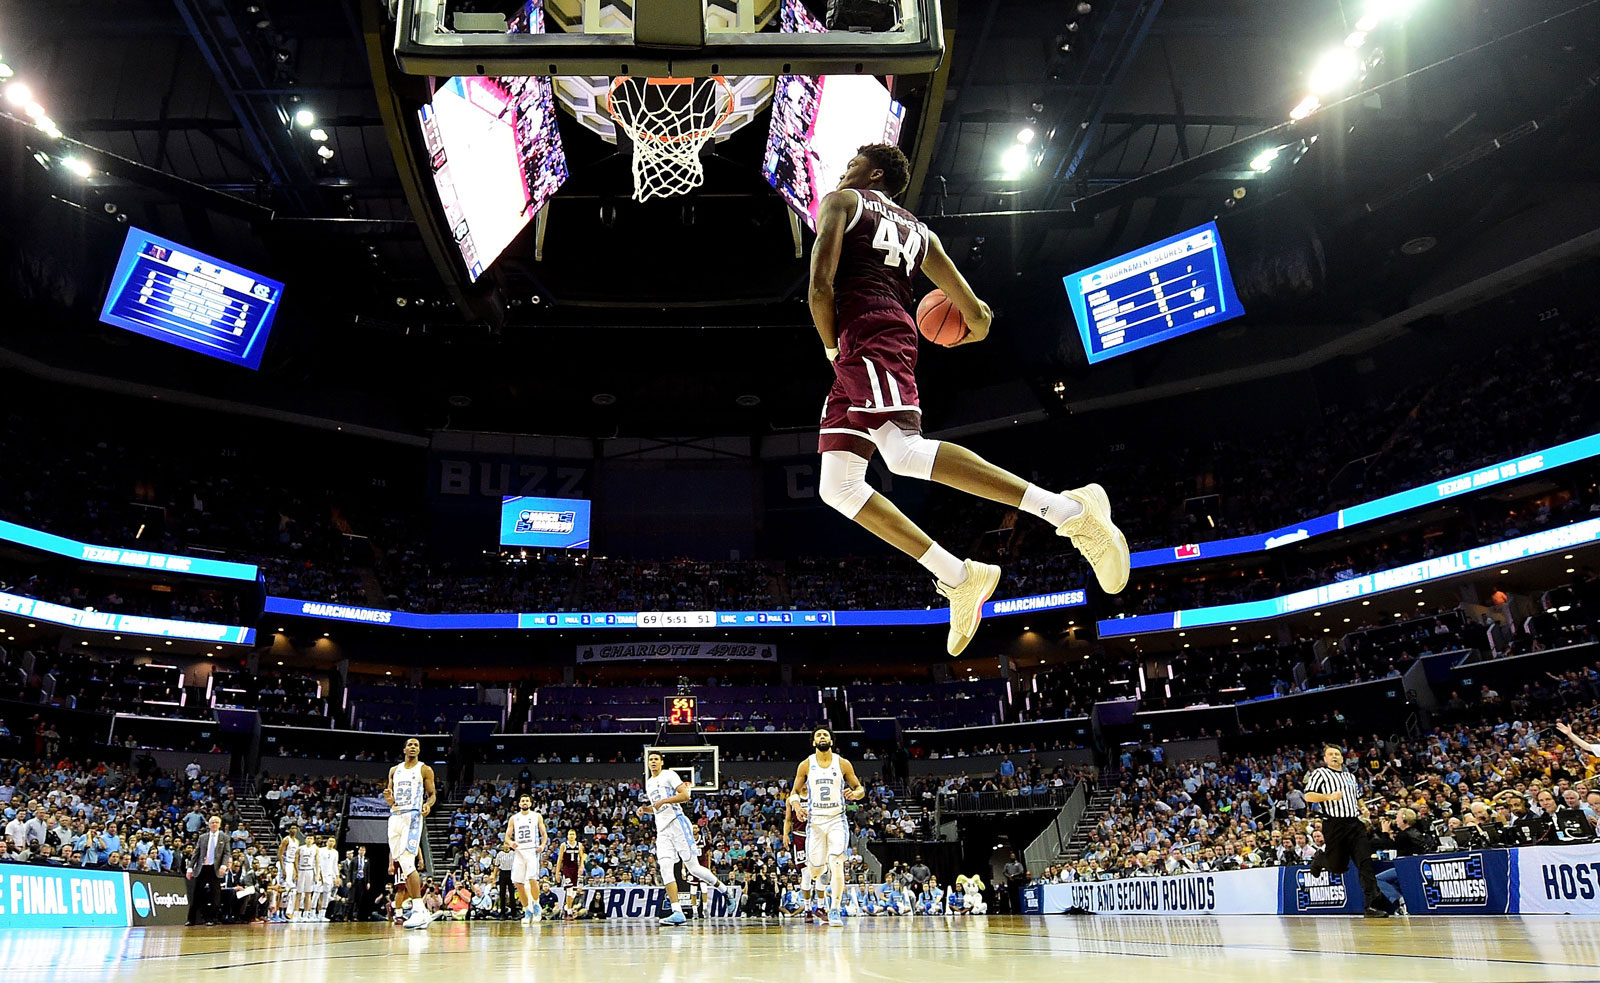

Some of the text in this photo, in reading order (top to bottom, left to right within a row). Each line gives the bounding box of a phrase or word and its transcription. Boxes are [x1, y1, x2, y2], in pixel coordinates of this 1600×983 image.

[872, 217, 921, 277] 44
[439, 460, 591, 498] BUZZ
[1437, 477, 1472, 497] TEXAS
[1500, 463, 1517, 478] VS
[82, 546, 120, 562] TEXAS
[149, 555, 166, 568] VS
[1374, 553, 1467, 591] BASKETBALL
[1469, 519, 1600, 568] CHAMPIONSHIP
[993, 591, 1084, 613] #MARCHMADNESS
[32, 601, 116, 630] BASKETBALL
[118, 615, 228, 640] CHAMPIONSHIP
[302, 602, 392, 624] #MARCHMADNESS
[643, 615, 657, 624] 69
[666, 616, 688, 625] 5:51
[697, 615, 710, 624] 51
[599, 644, 757, 658] CHARLOTTE 49ERS
[671, 708, 691, 725] 27
[1369, 760, 1380, 769] 10
[820, 786, 831, 801] 2
[518, 829, 531, 840] 32
[1303, 871, 1330, 887] MARCH
[1431, 861, 1467, 881] MARCH
[10, 874, 68, 915] FINAL
[70, 878, 118, 915] FOUR
[1097, 883, 1115, 911] AND
[1117, 880, 1158, 911] SECOND
[1162, 876, 1215, 910] ROUNDS
[1309, 885, 1345, 902] MADNESS
[1439, 879, 1486, 899] MADNESS
[153, 891, 173, 909] Google
[172, 893, 189, 906] Cloud
